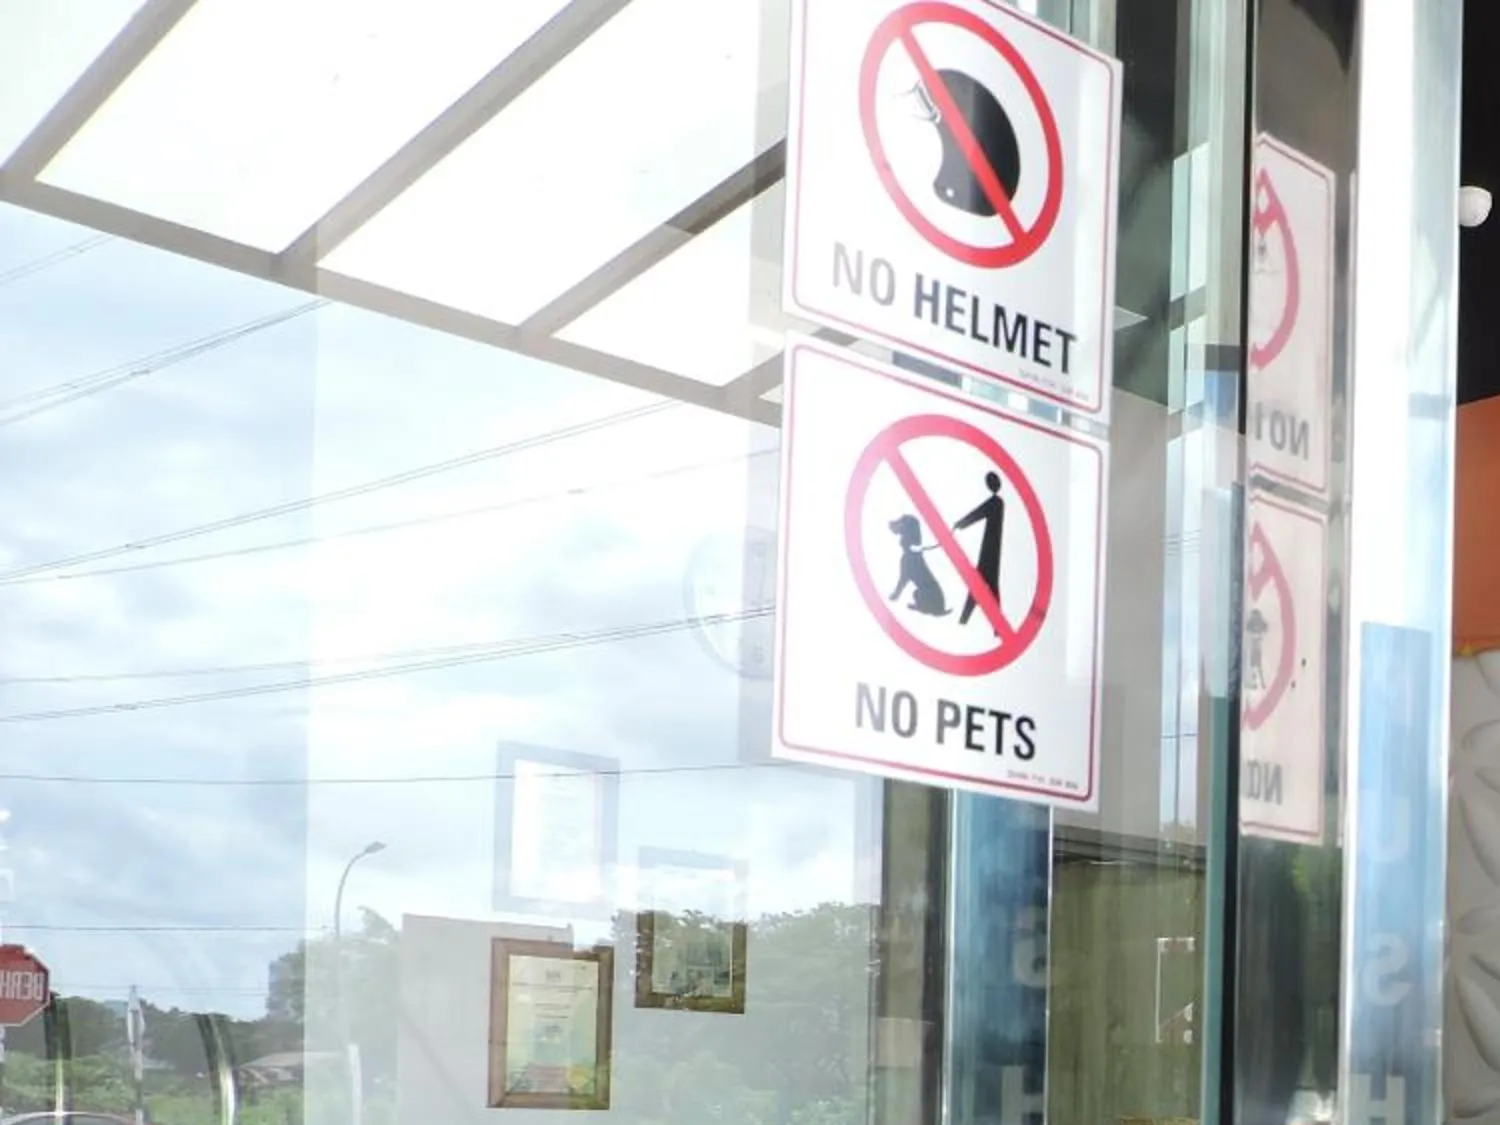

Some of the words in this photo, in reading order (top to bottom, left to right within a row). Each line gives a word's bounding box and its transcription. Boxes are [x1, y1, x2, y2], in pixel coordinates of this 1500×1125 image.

[832, 241, 896, 307] NO
[913, 272, 1077, 374] HELMET
[855, 681, 918, 738] NO
[935, 698, 1037, 761] PETS
